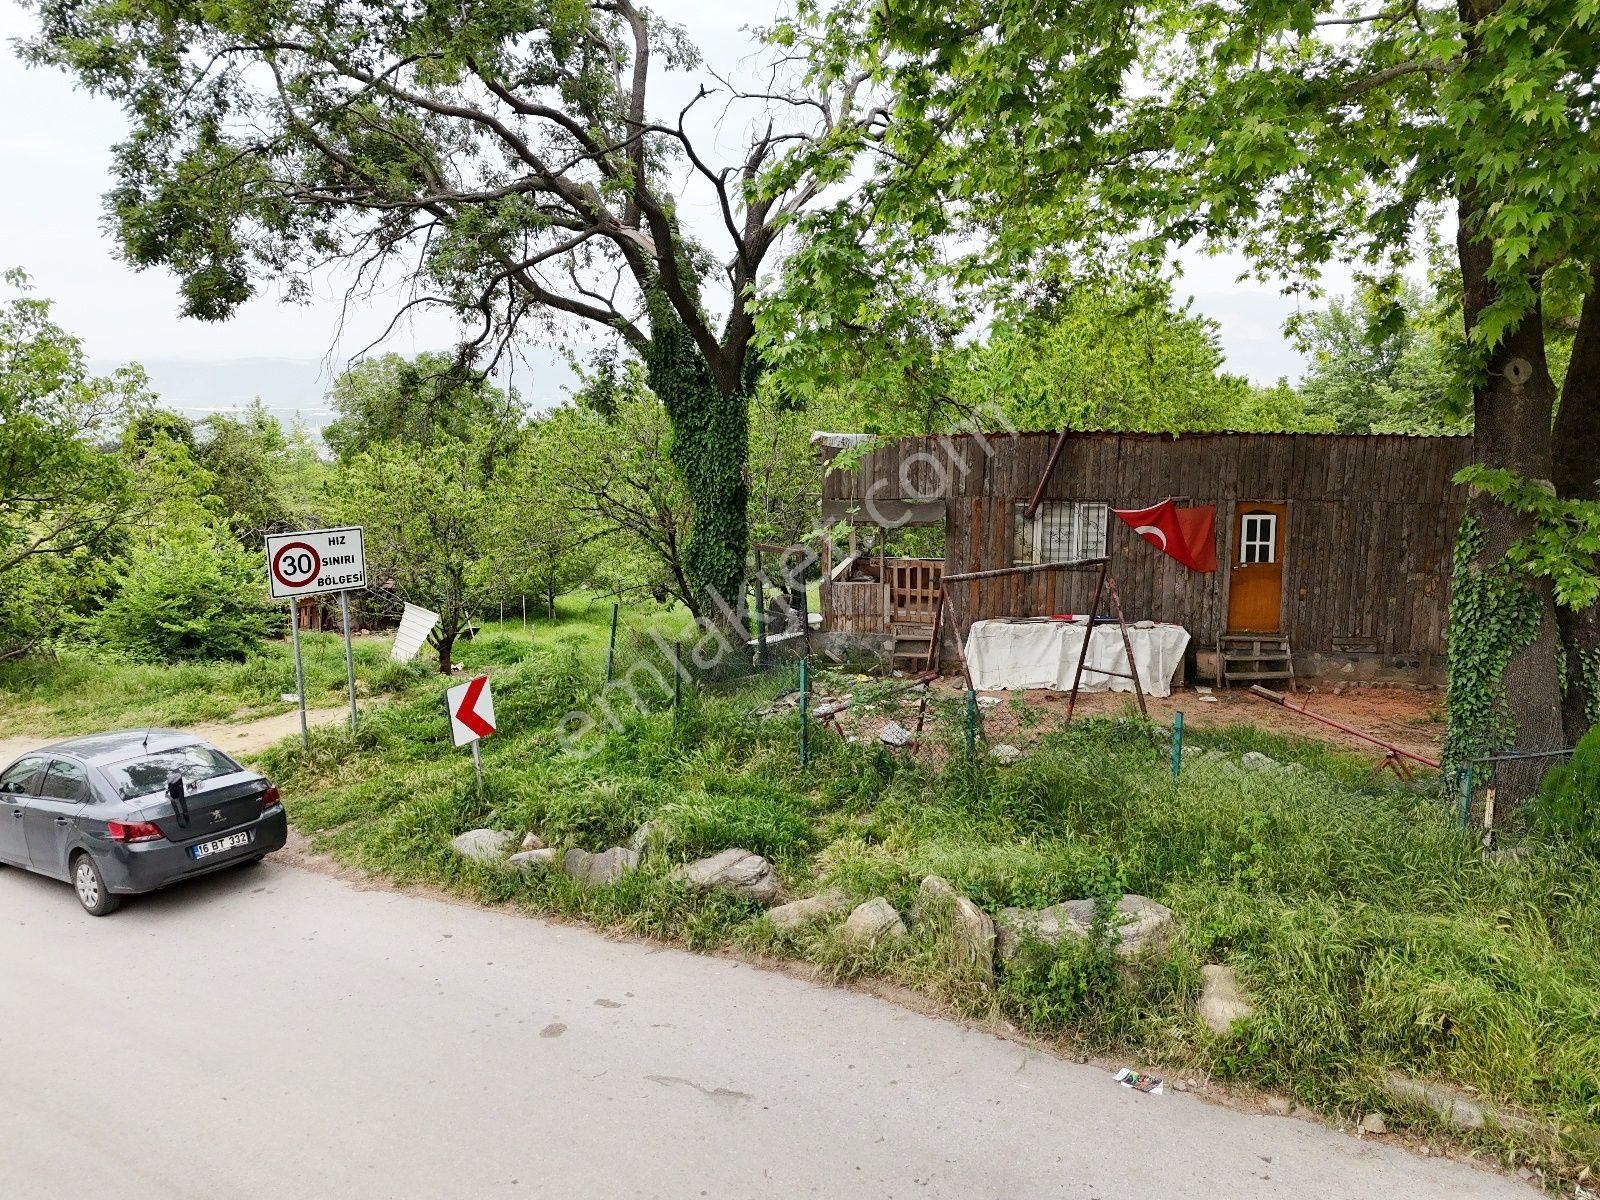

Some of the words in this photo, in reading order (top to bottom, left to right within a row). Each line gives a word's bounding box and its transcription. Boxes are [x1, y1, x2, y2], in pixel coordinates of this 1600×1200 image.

[328, 536, 346, 546] HIZ
[282, 553, 312, 576] 30
[321, 555, 355, 567] SINIRI
[317, 571, 363, 587] BÖLGESİ
[199, 844, 210, 854] 16
[212, 839, 224, 851] BT
[229, 833, 247, 846] 332
